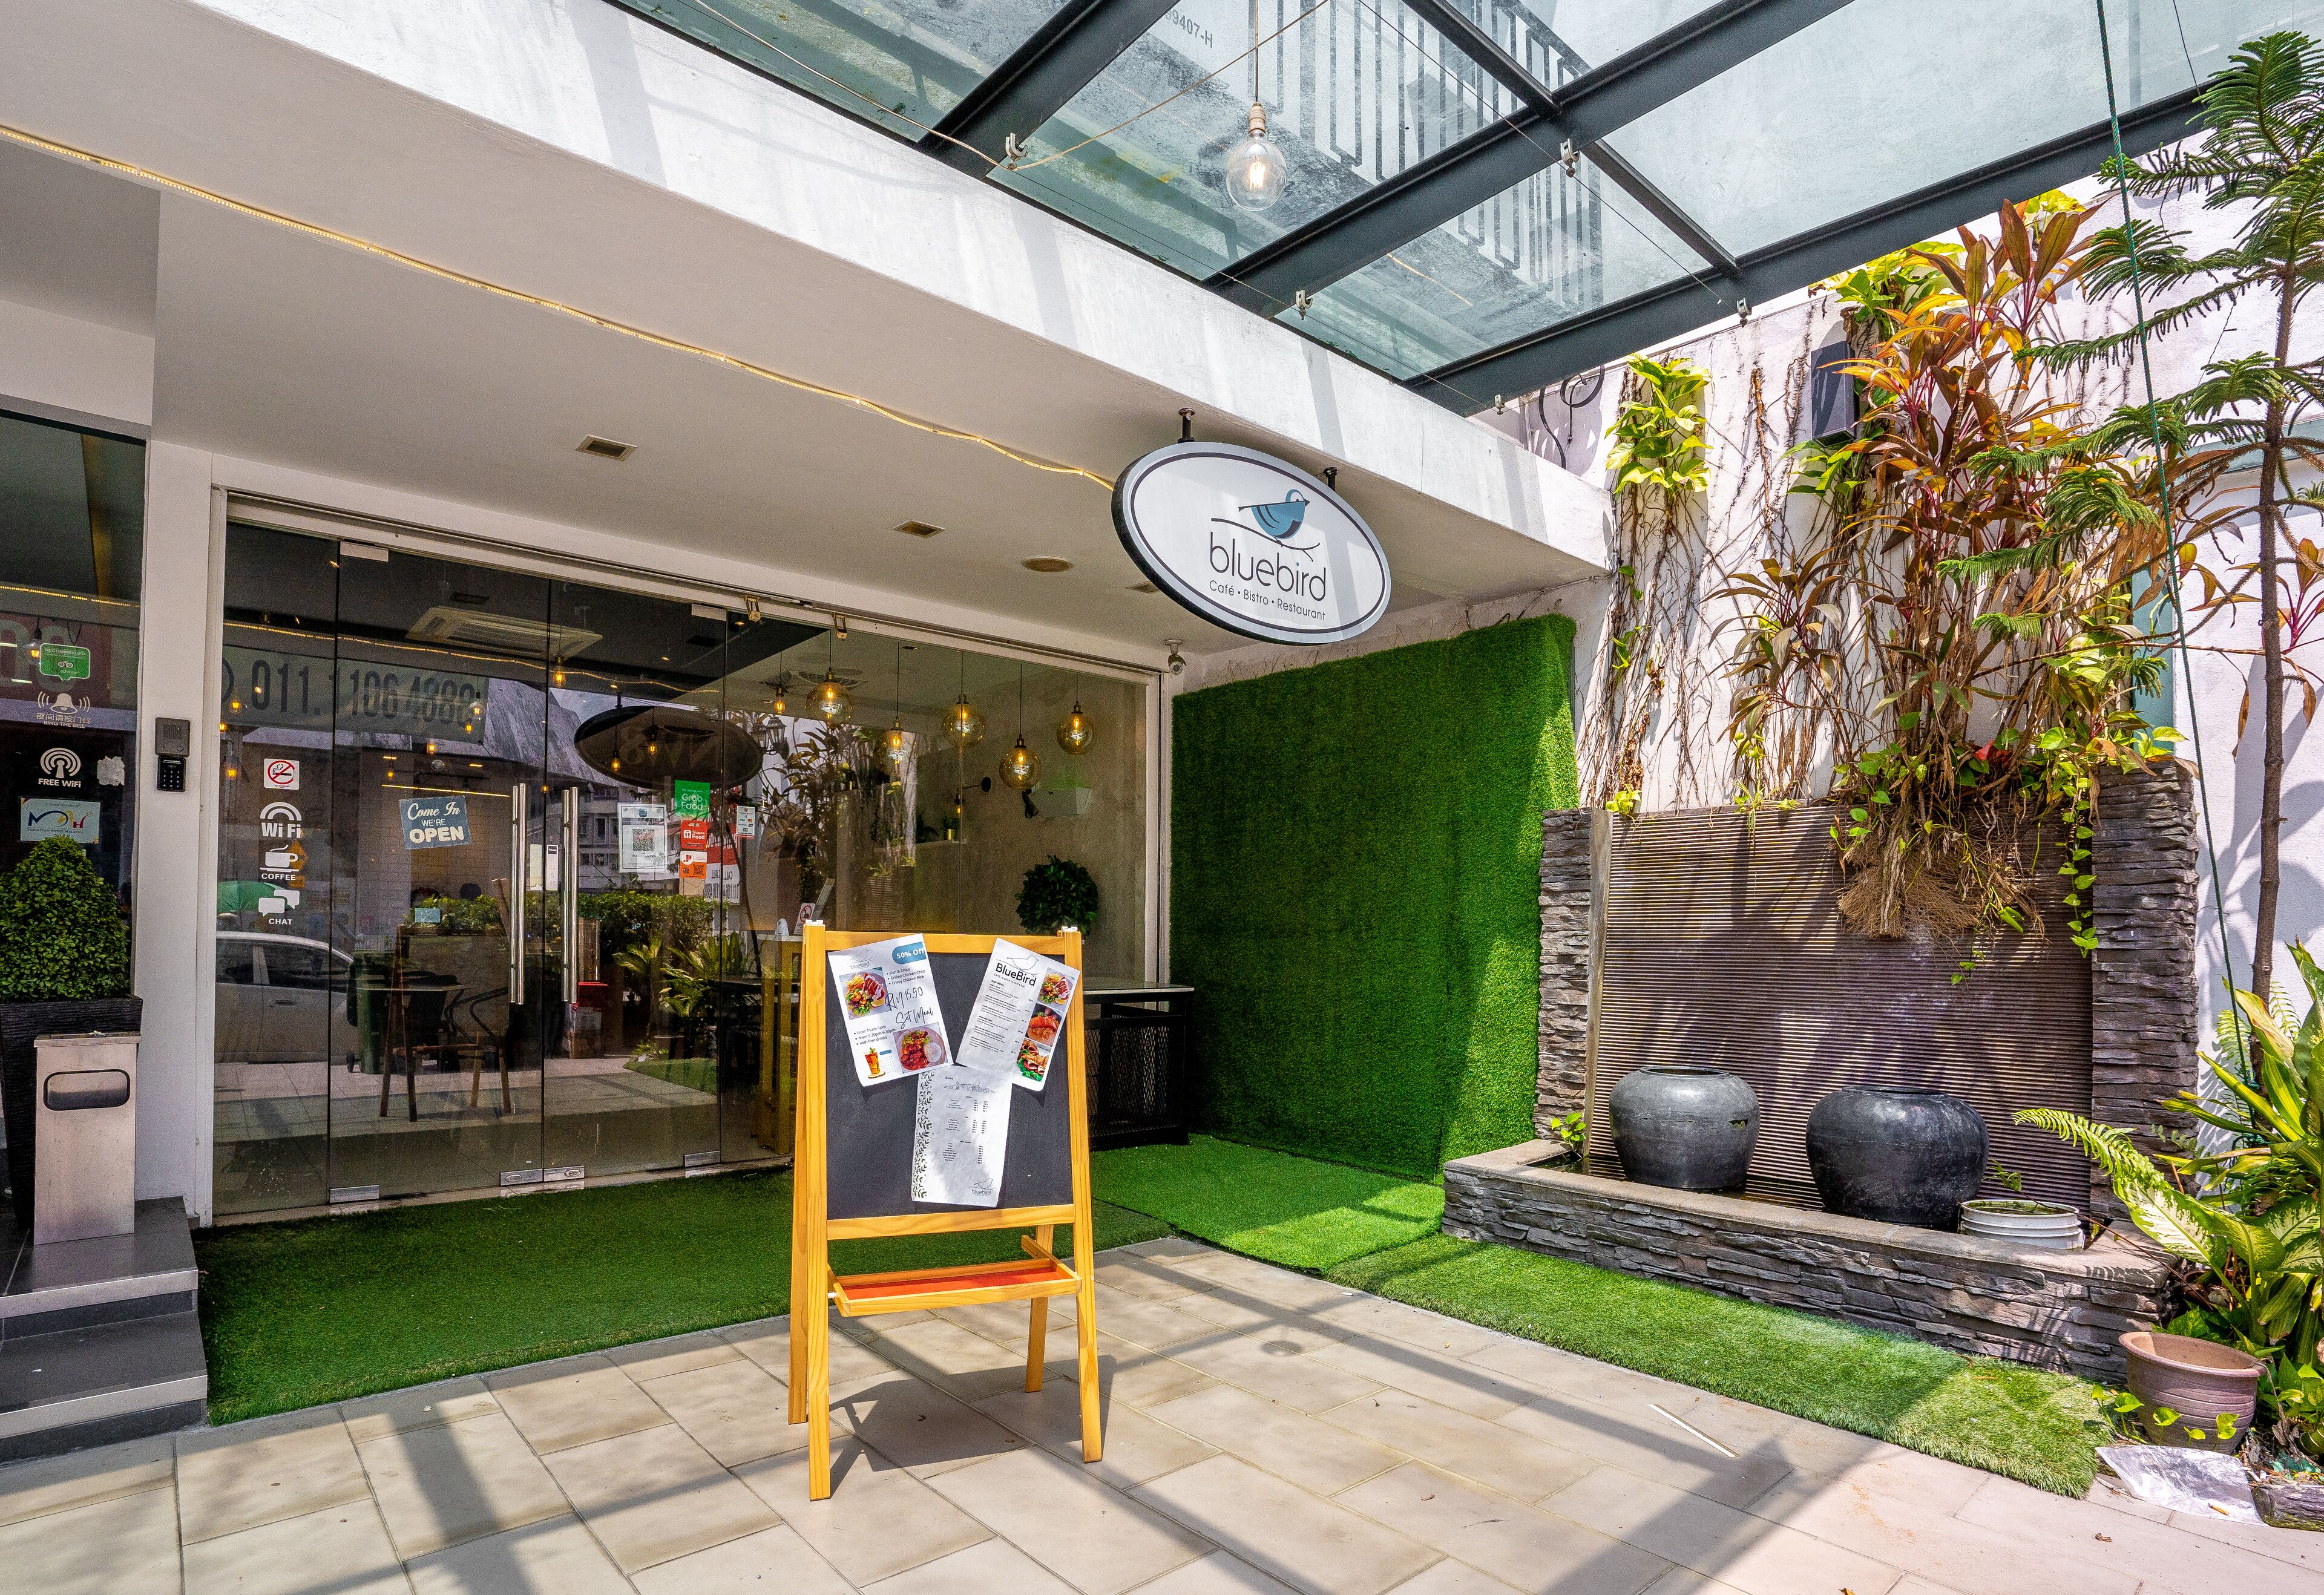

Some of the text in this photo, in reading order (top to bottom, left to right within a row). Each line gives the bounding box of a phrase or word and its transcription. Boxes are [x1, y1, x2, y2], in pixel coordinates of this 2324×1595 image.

[1210, 532, 1326, 601] bluebird
[1209, 580, 1325, 621] Café Bistro Restaurant
[681, 793, 703, 802] Grab
[681, 802, 703, 810] Food
[407, 802, 461, 820] Come In
[421, 819, 447, 827] WE'RE
[410, 826, 464, 843] OPEN
[913, 947, 926, 955] Off
[850, 961, 870, 969] bluebird
[996, 963, 1037, 986] BlueBird
[885, 986, 924, 1011] RM 15.90
[896, 1006, 934, 1029] Set Meal
